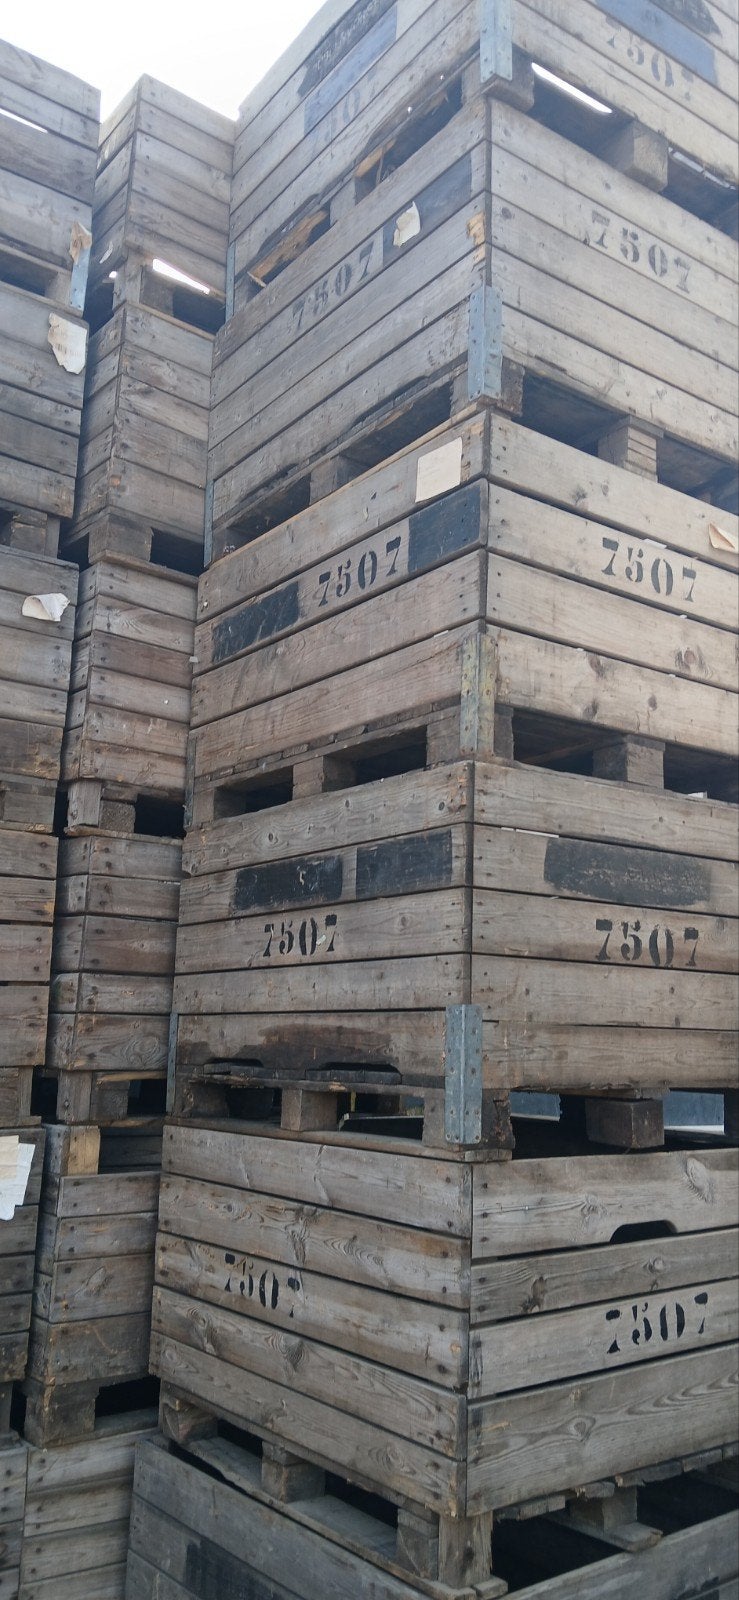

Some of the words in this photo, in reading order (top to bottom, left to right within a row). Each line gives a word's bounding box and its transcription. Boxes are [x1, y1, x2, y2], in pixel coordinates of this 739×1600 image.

[290, 240, 374, 330] 7507
[592, 210, 692, 295] 7507
[317, 537, 402, 607] 7507
[601, 537, 696, 602] 7507
[262, 914, 337, 957] 7507
[595, 918, 699, 968] 7507
[224, 1252, 300, 1318] 7507
[606, 1292, 708, 1354] 7507
